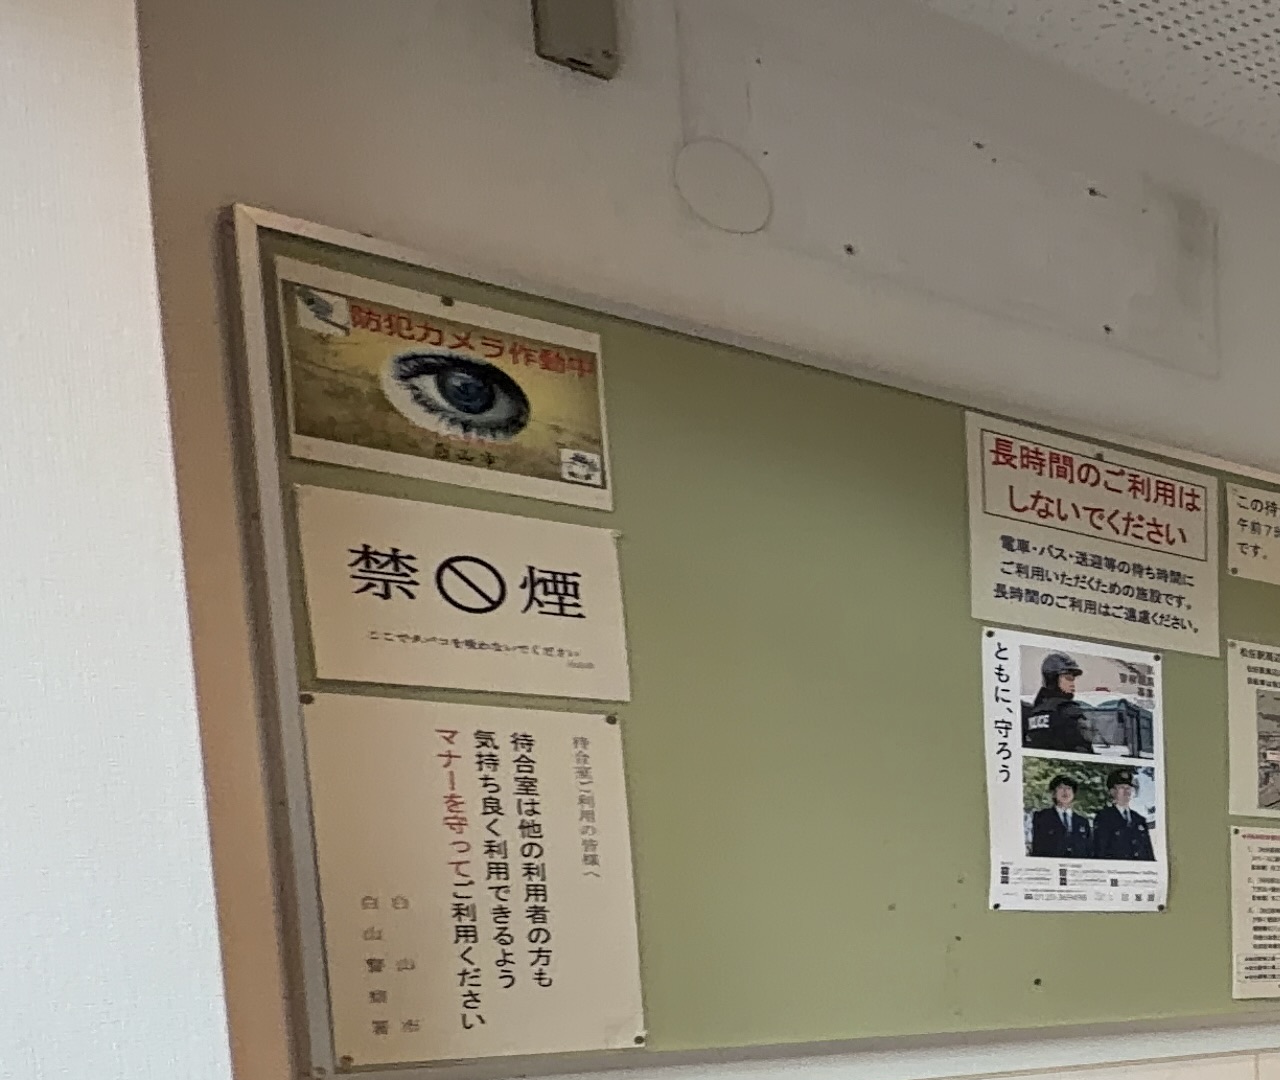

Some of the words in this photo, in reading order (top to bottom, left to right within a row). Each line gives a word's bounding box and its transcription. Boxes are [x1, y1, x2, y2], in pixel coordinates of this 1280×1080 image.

[351, 305, 597, 377] 防犯カメラ作動中
[990, 437, 1201, 513] 長時間のご利用は
[1006, 486, 1188, 546] しないでください
[1237, 542, 1268, 560] です。
[347, 543, 421, 601] 禁
[518, 565, 587, 620] 煙
[993, 583, 1199, 633] 長時間のご利用はご遠慮ください。
[1000, 561, 1192, 611] ご利用いただくための施設です。
[994, 642, 1013, 783] ともに、守ろう
[435, 728, 486, 1031] マナーを守ってご利用ください
[474, 729, 517, 989] 気持ち良く利用できるよう
[510, 732, 553, 988] 待合室は他の利用者の方も
